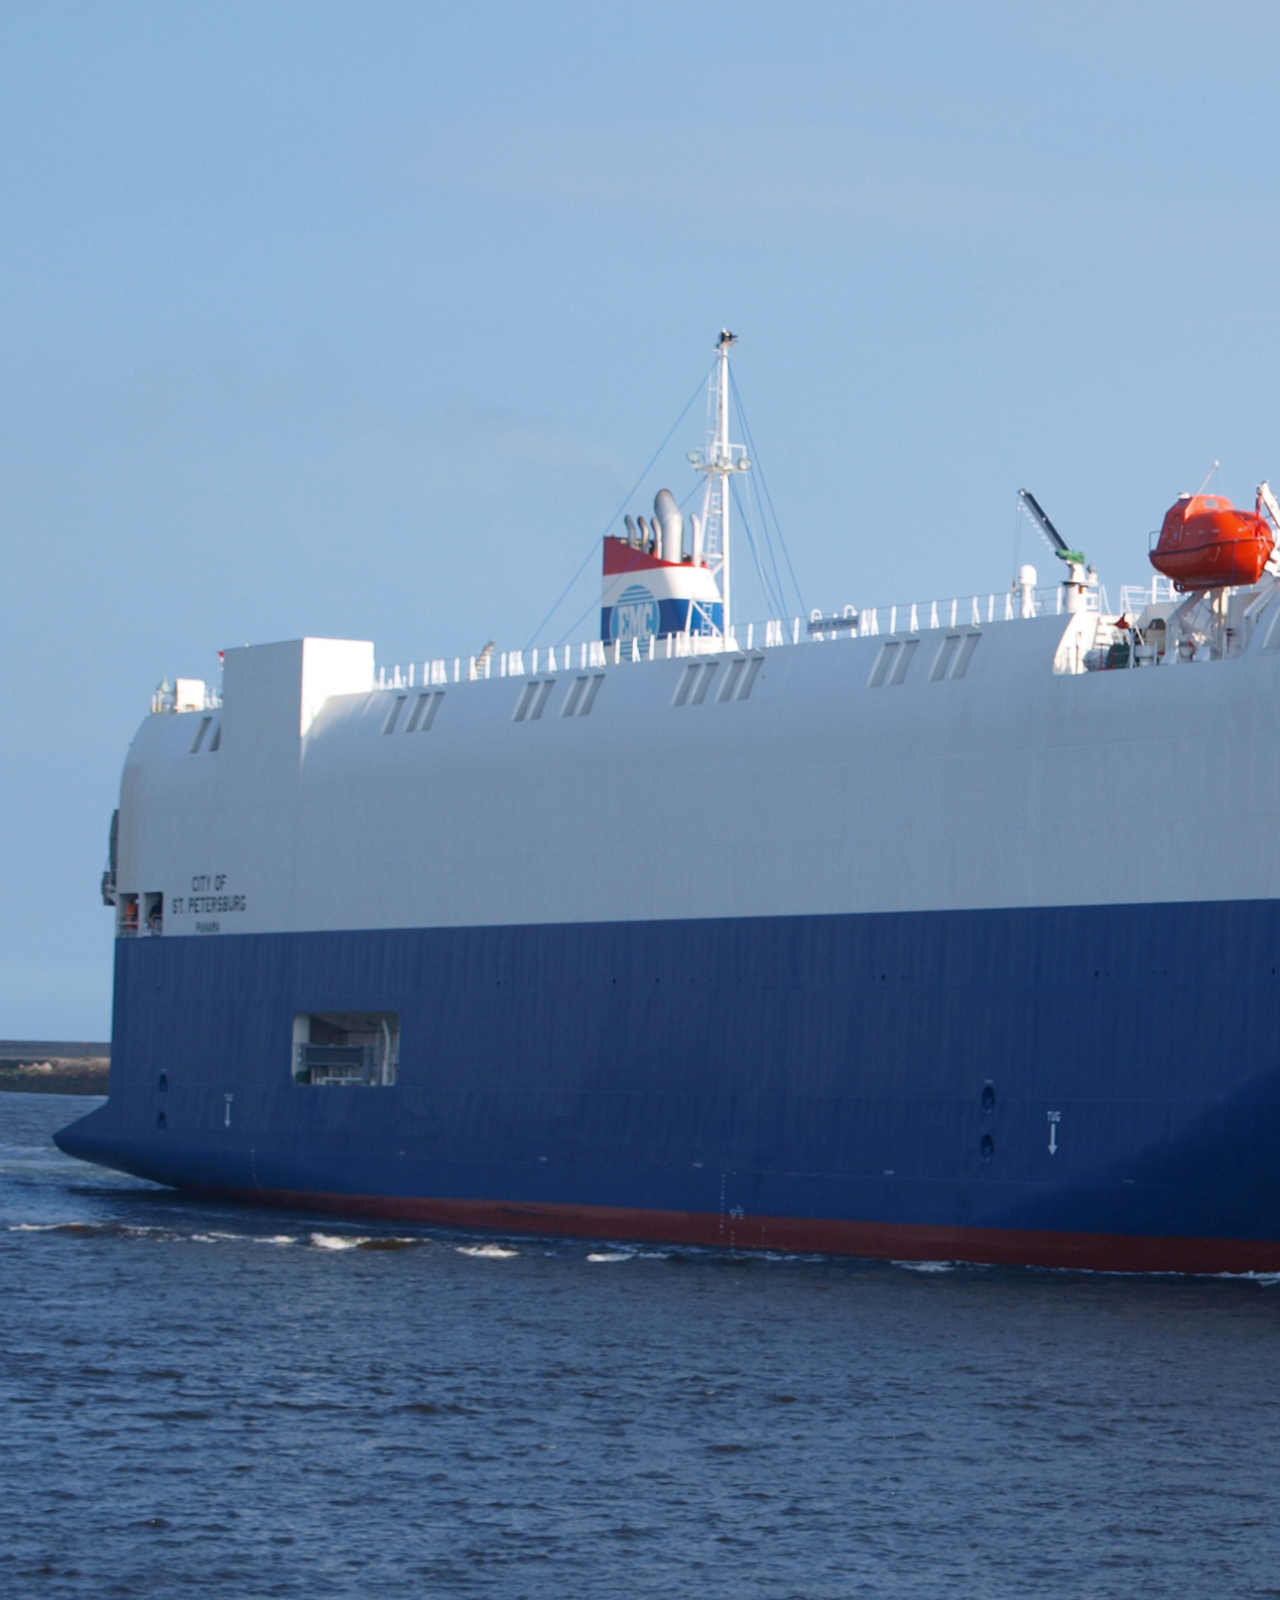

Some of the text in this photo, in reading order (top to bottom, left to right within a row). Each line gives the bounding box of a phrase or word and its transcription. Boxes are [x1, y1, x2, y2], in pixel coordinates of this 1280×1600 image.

[193, 874, 226, 892] CITY OF
[189, 895, 246, 913] PETERSBURG
